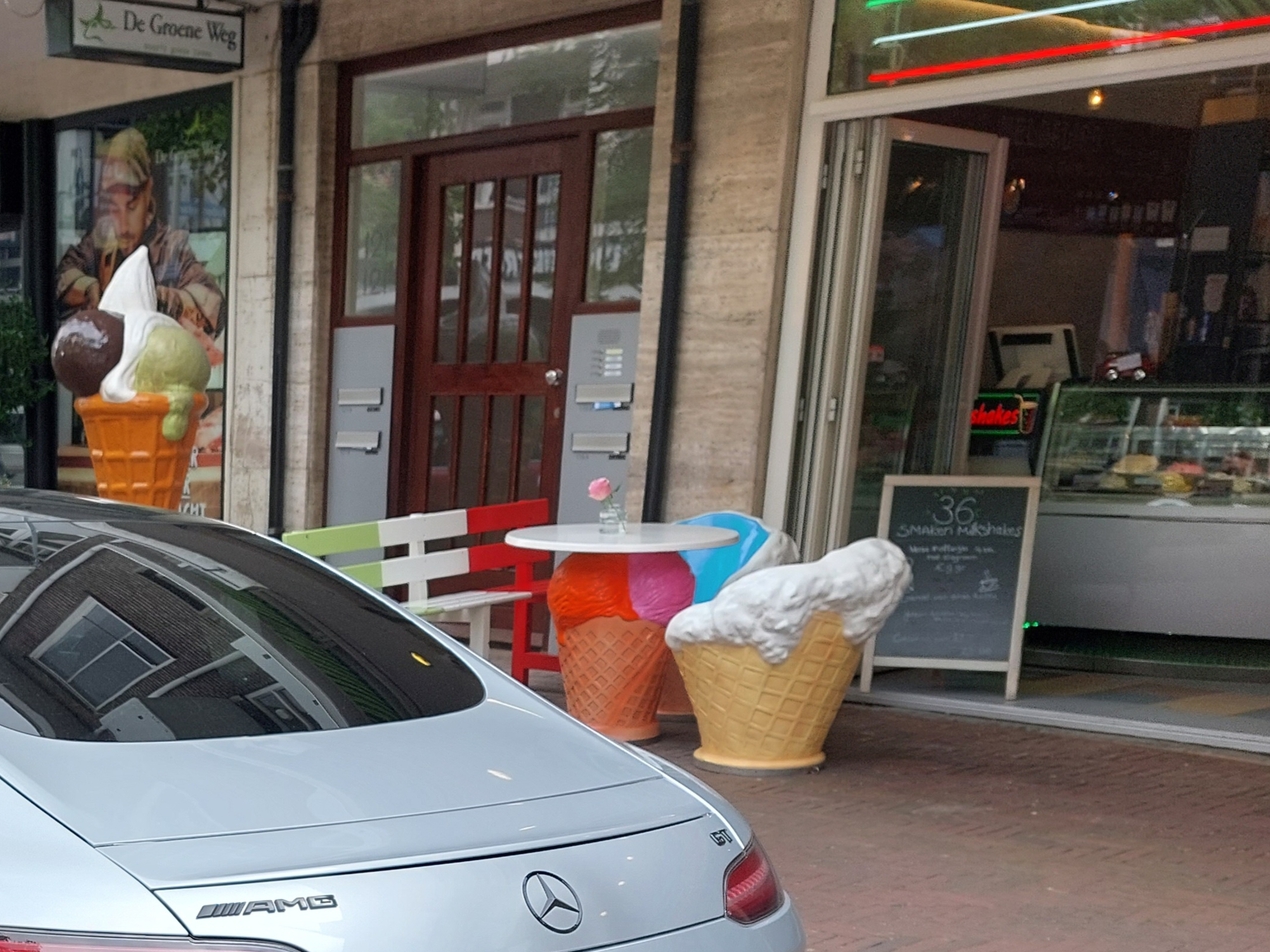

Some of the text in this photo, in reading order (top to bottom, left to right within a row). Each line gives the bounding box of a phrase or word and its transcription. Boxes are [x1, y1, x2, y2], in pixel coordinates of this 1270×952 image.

[123, 10, 145, 32] De
[149, 13, 202, 40] Groene
[207, 20, 237, 51] Weg
[933, 495, 977, 525] 36
[709, 828, 734, 846] GT
[243, 895, 338, 915] AMG
